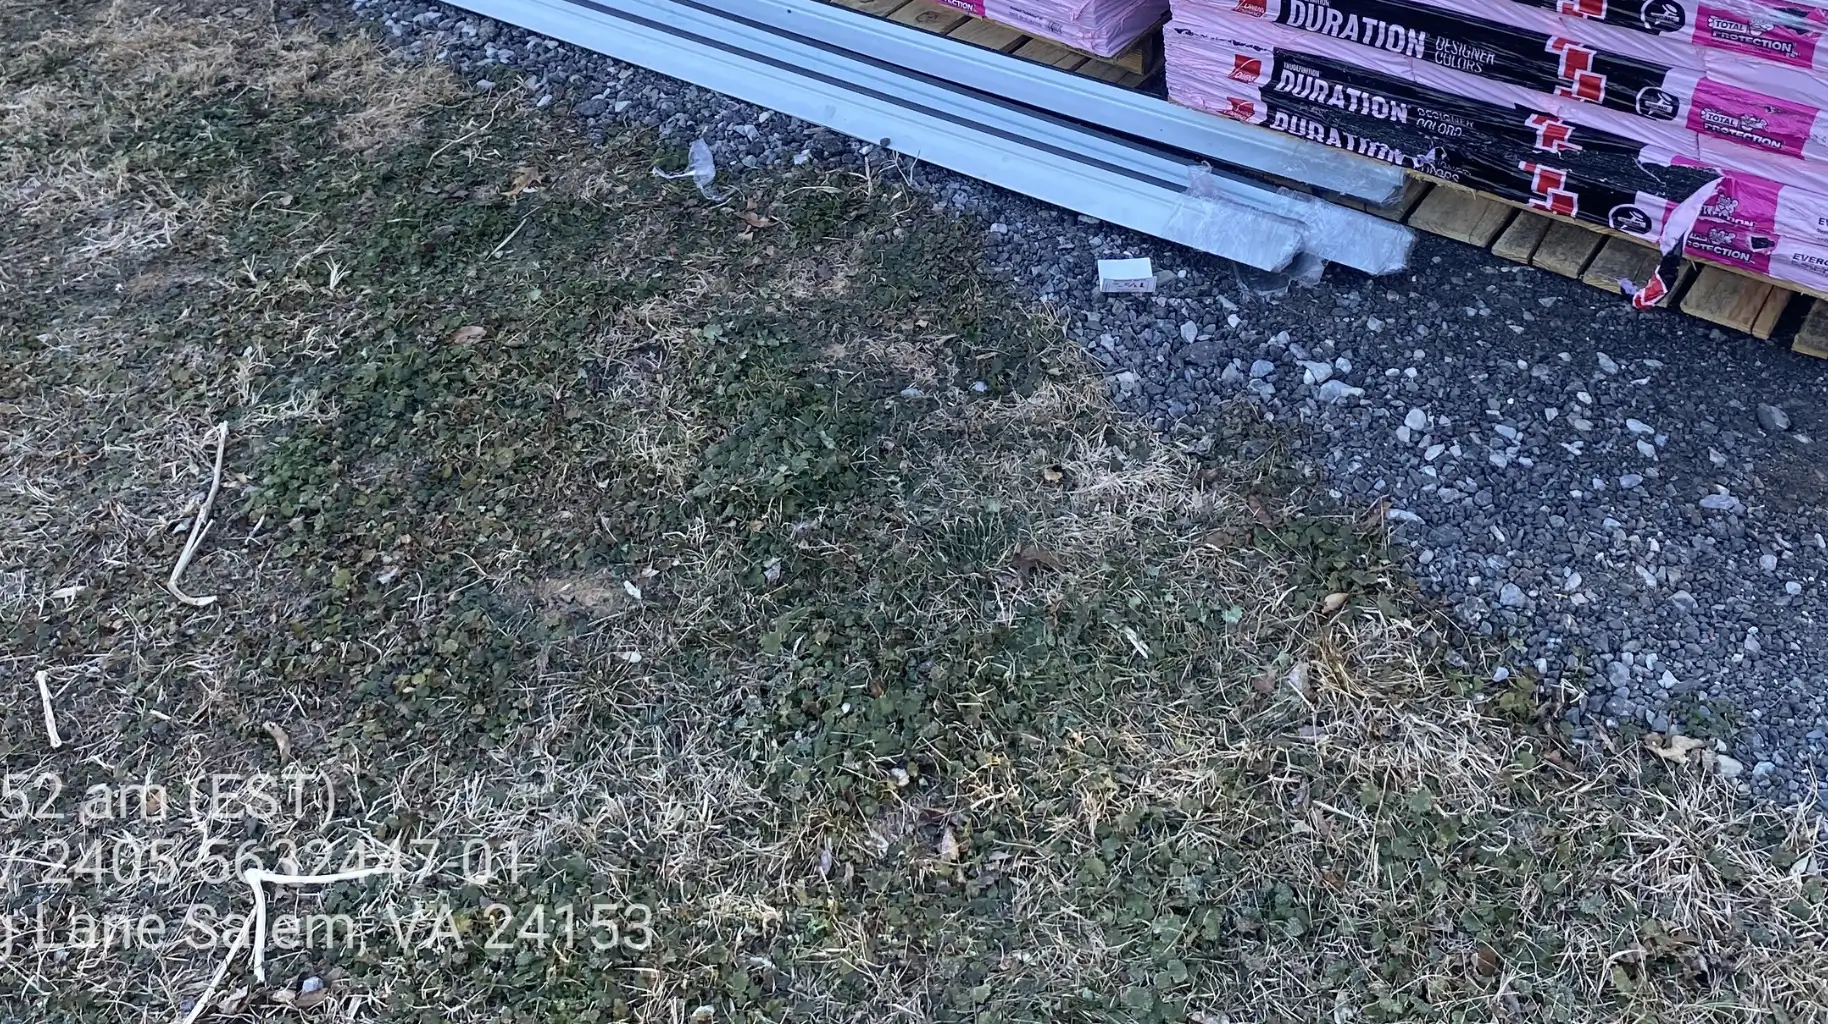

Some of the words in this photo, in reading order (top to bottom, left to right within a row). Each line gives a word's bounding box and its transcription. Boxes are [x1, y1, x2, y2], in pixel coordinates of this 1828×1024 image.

[1715, 19, 1745, 32] TOTAL
[1435, 36, 1495, 65] DESIGNER
[1712, 31, 1793, 53] PROTECTION
[1434, 51, 1483, 73] COLORS
[1274, 70, 1408, 124] DURATION
[1708, 113, 1735, 126] TOTAL
[1270, 111, 1402, 165] DURATION
[1704, 123, 1782, 149] PROTECTION
